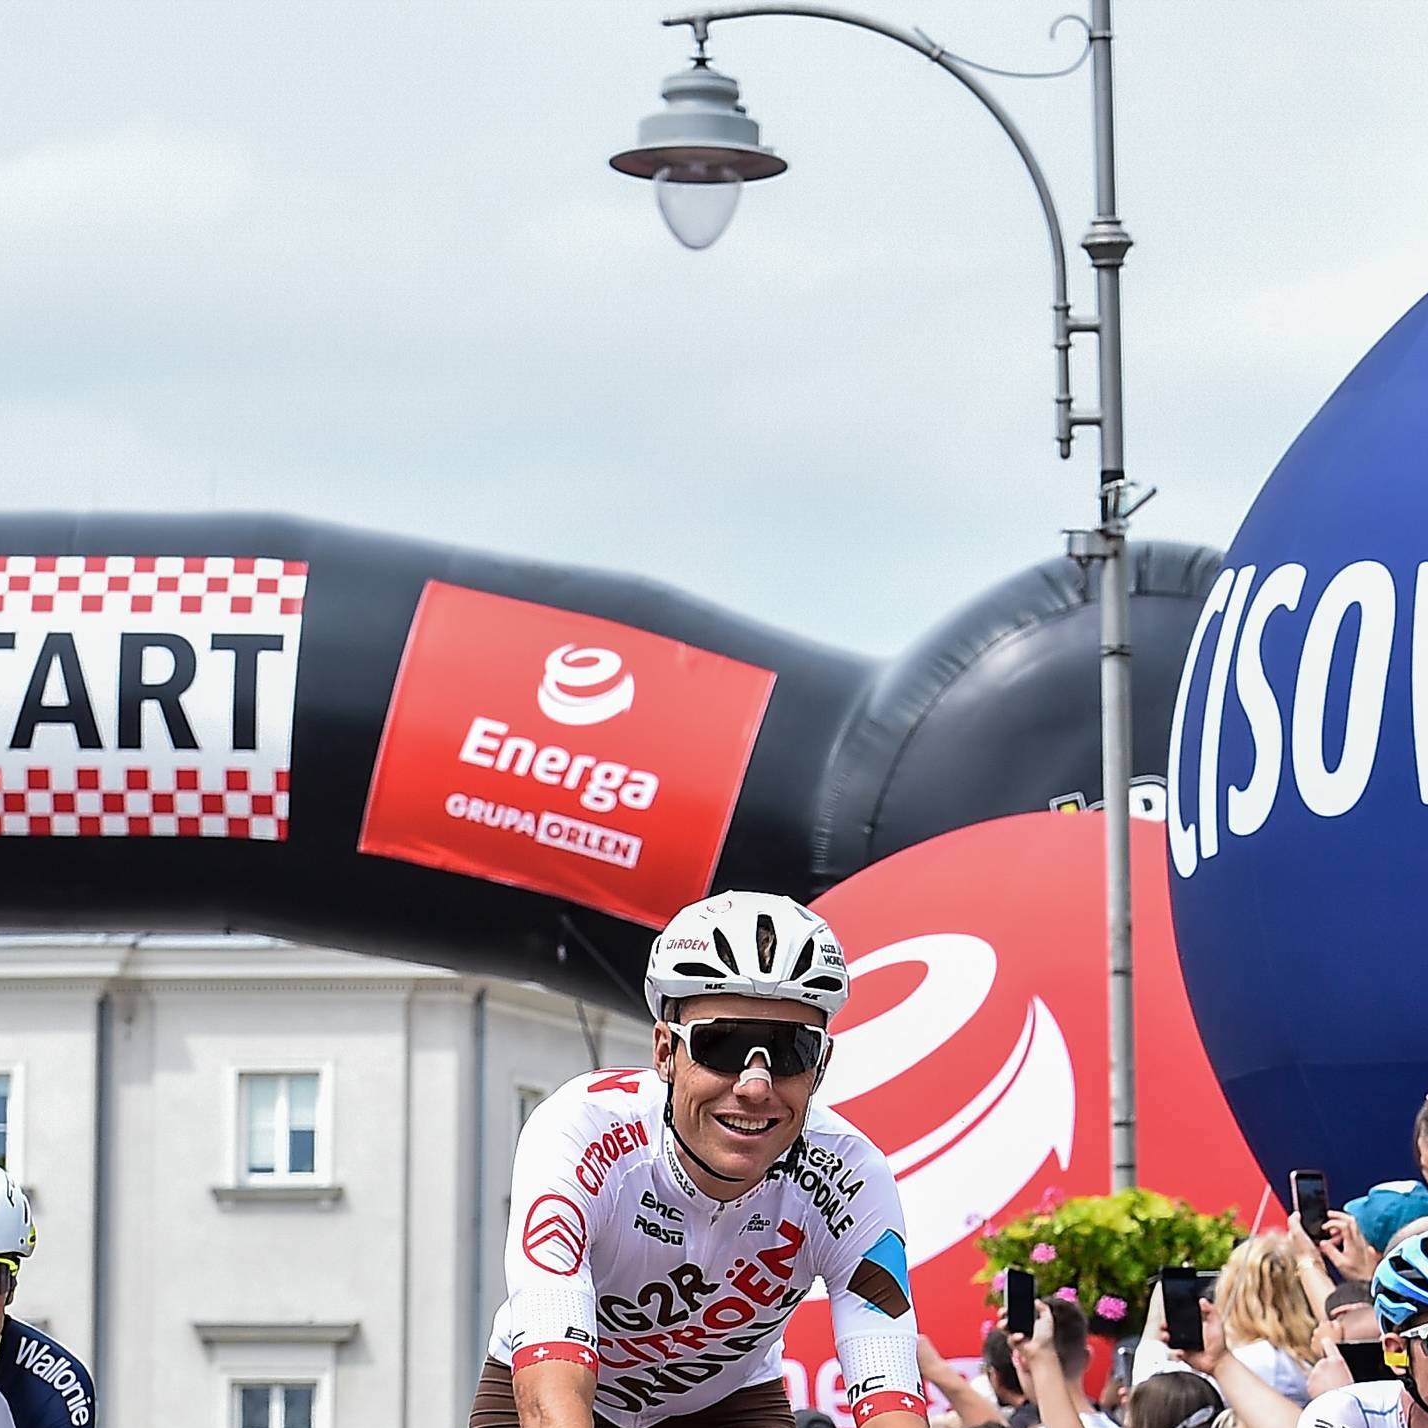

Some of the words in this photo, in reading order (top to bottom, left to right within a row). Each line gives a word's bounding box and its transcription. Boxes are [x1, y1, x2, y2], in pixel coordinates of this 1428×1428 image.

[459, 717, 659, 812] Energa
[445, 793, 538, 837] GRUPA
[546, 821, 631, 860] ORLEN
[576, 1120, 649, 1198] CITROËN
[597, 1219, 807, 1369] CITROËN
[15, 1336, 90, 1427] Wallonie
